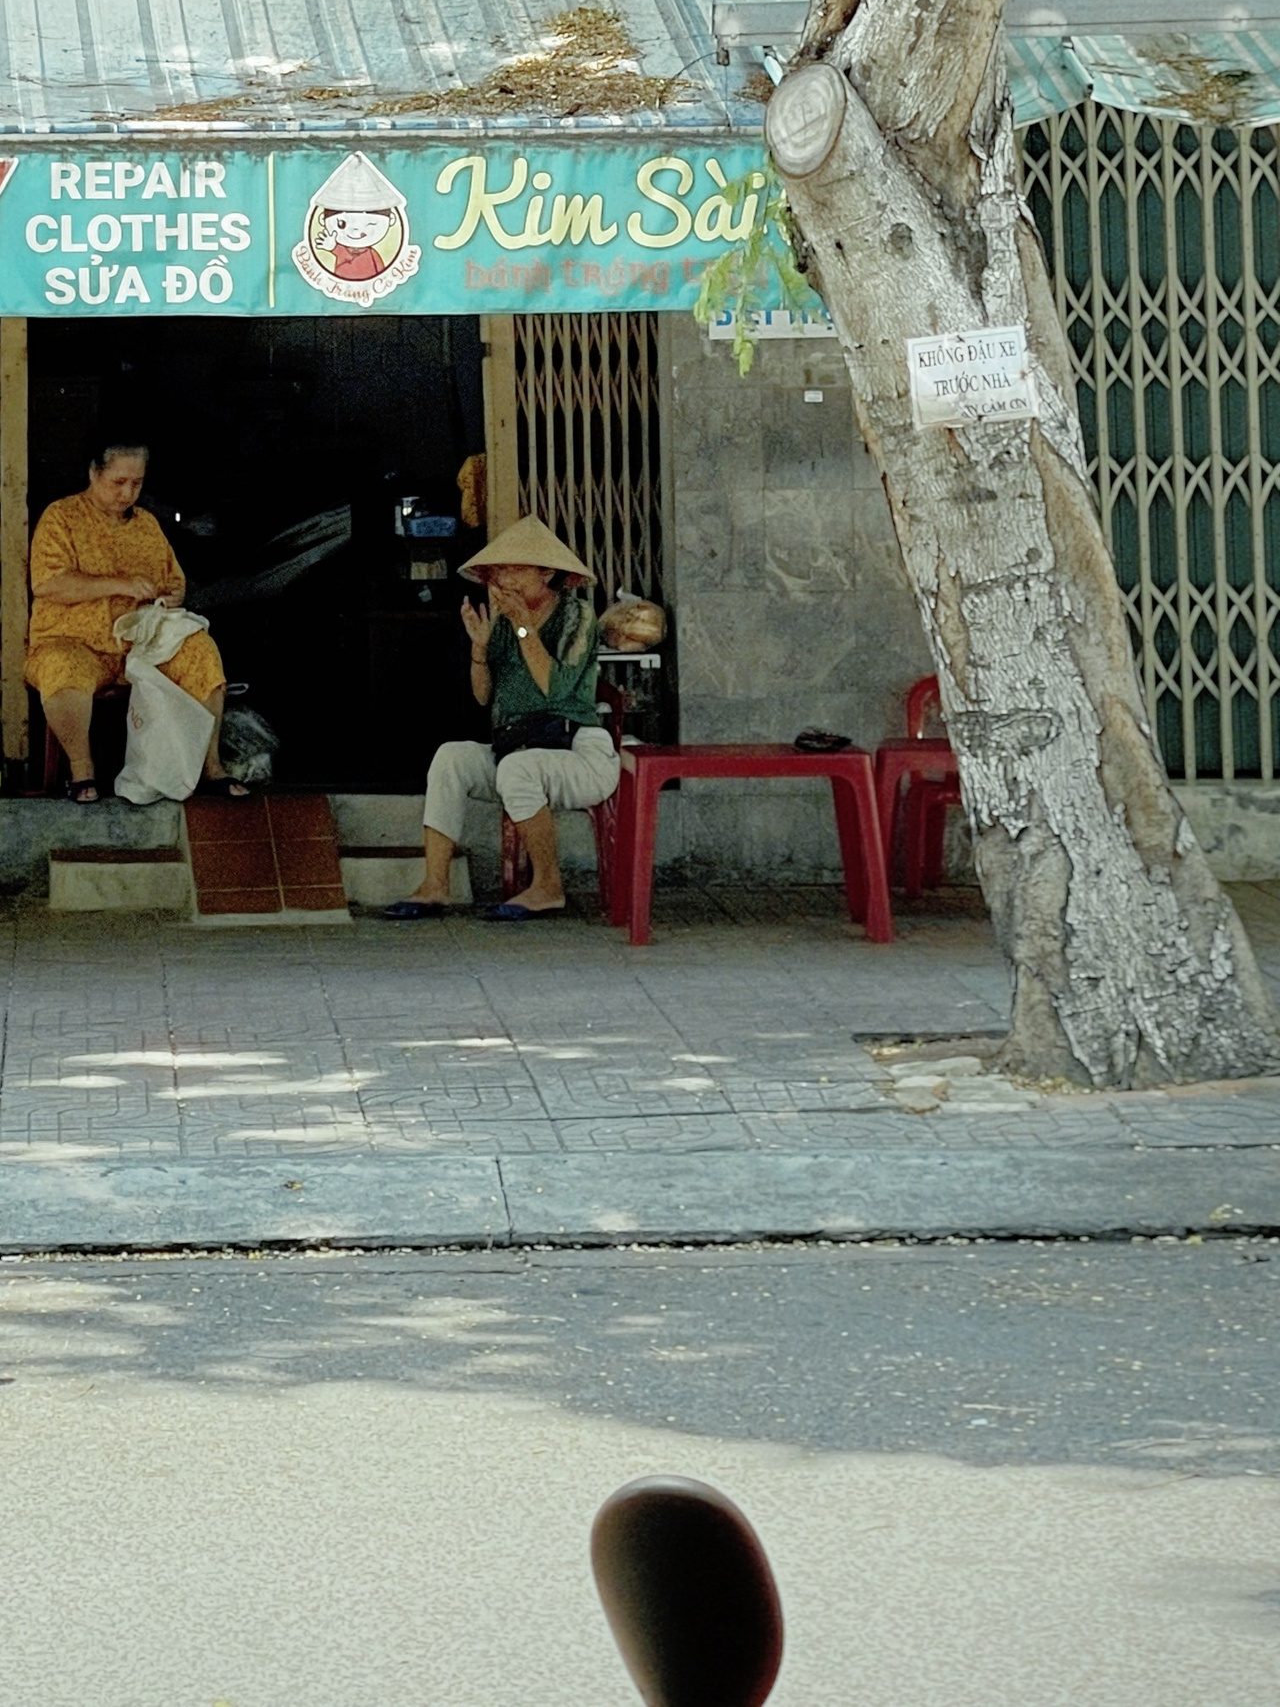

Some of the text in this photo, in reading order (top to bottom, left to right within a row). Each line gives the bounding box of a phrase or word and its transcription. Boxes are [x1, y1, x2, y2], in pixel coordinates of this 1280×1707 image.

[51, 161, 227, 199] REPAIR
[433, 155, 766, 249] Kim Sài
[25, 212, 251, 253] CLOTHES
[45, 254, 234, 305] SỬA ĐỒ
[391, 248, 419, 281] Kim
[919, 345, 964, 368] KHÔNG
[999, 340, 1018, 358] XE
[934, 366, 1012, 396] TRƯỚC NHÀ
